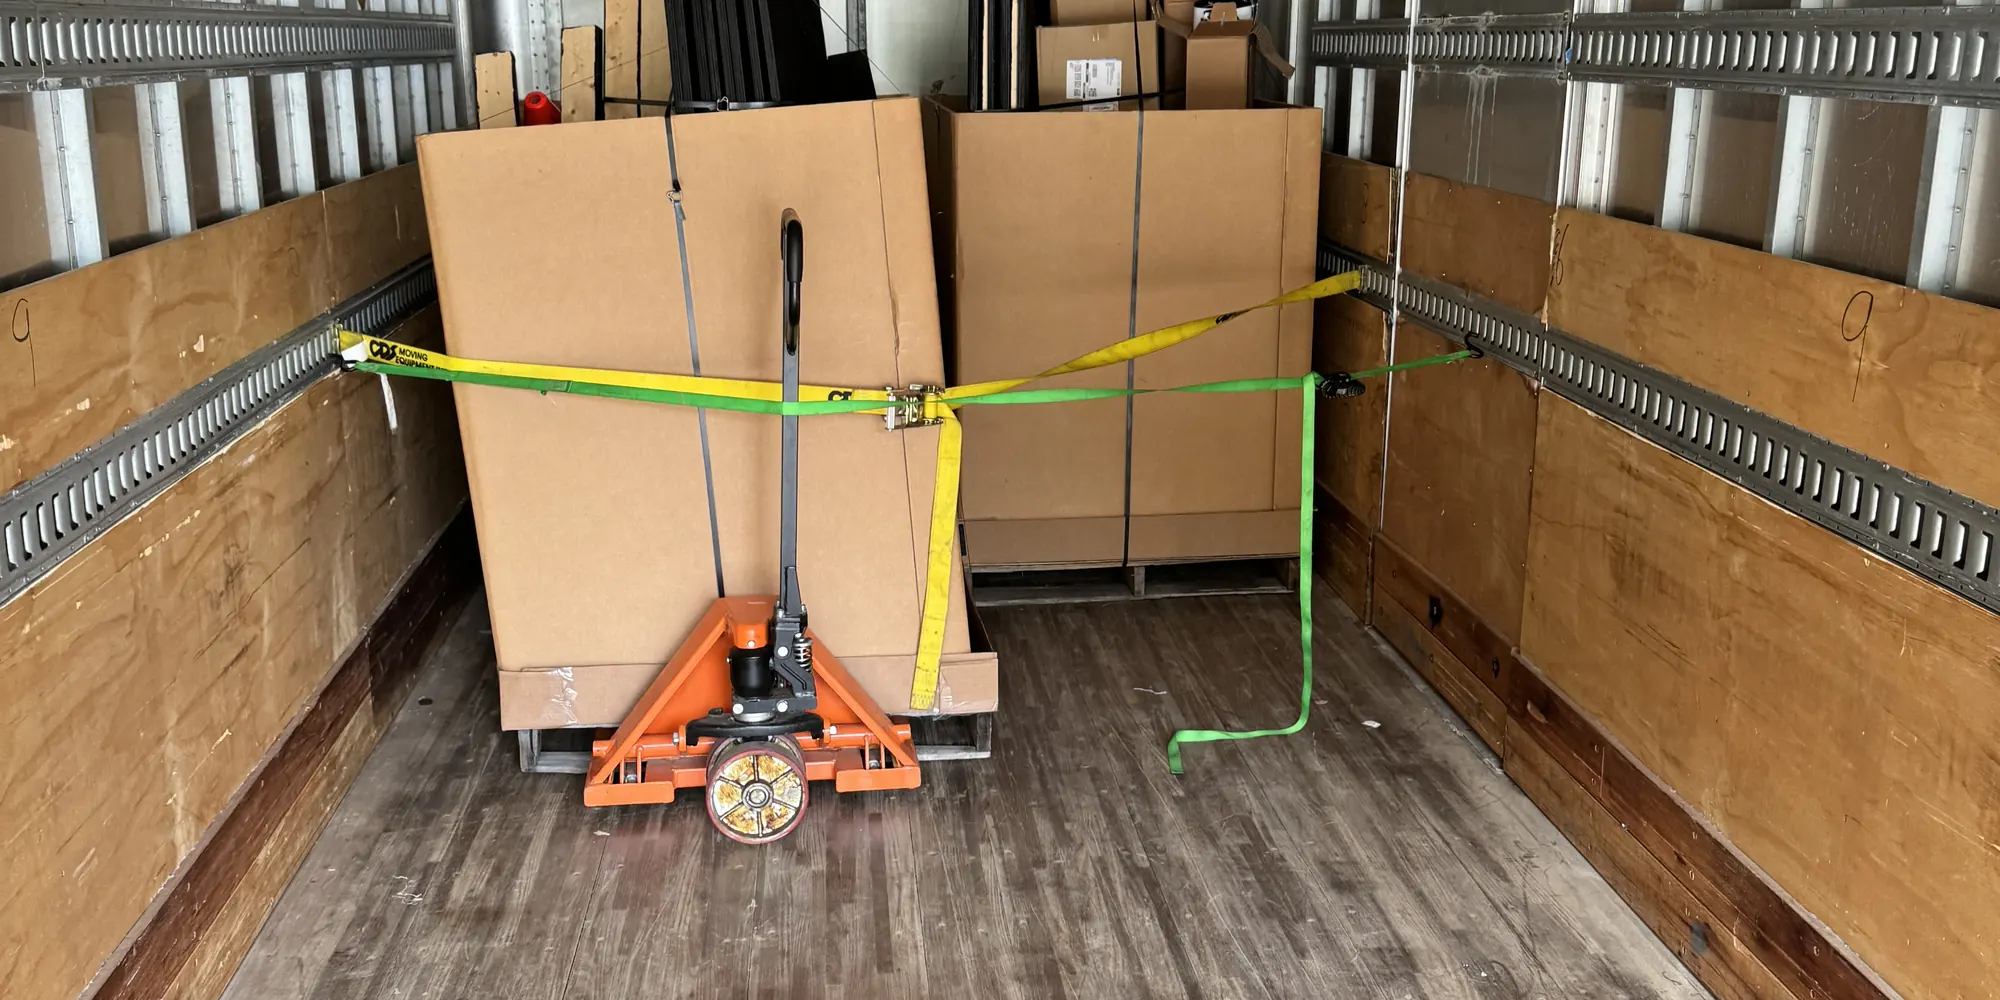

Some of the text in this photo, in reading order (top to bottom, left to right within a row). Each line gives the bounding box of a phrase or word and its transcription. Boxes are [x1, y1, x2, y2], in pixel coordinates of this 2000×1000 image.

[369, 339, 398, 361] CDS
[398, 347, 429, 362] MOVING
[1841, 290, 1874, 402] 9
